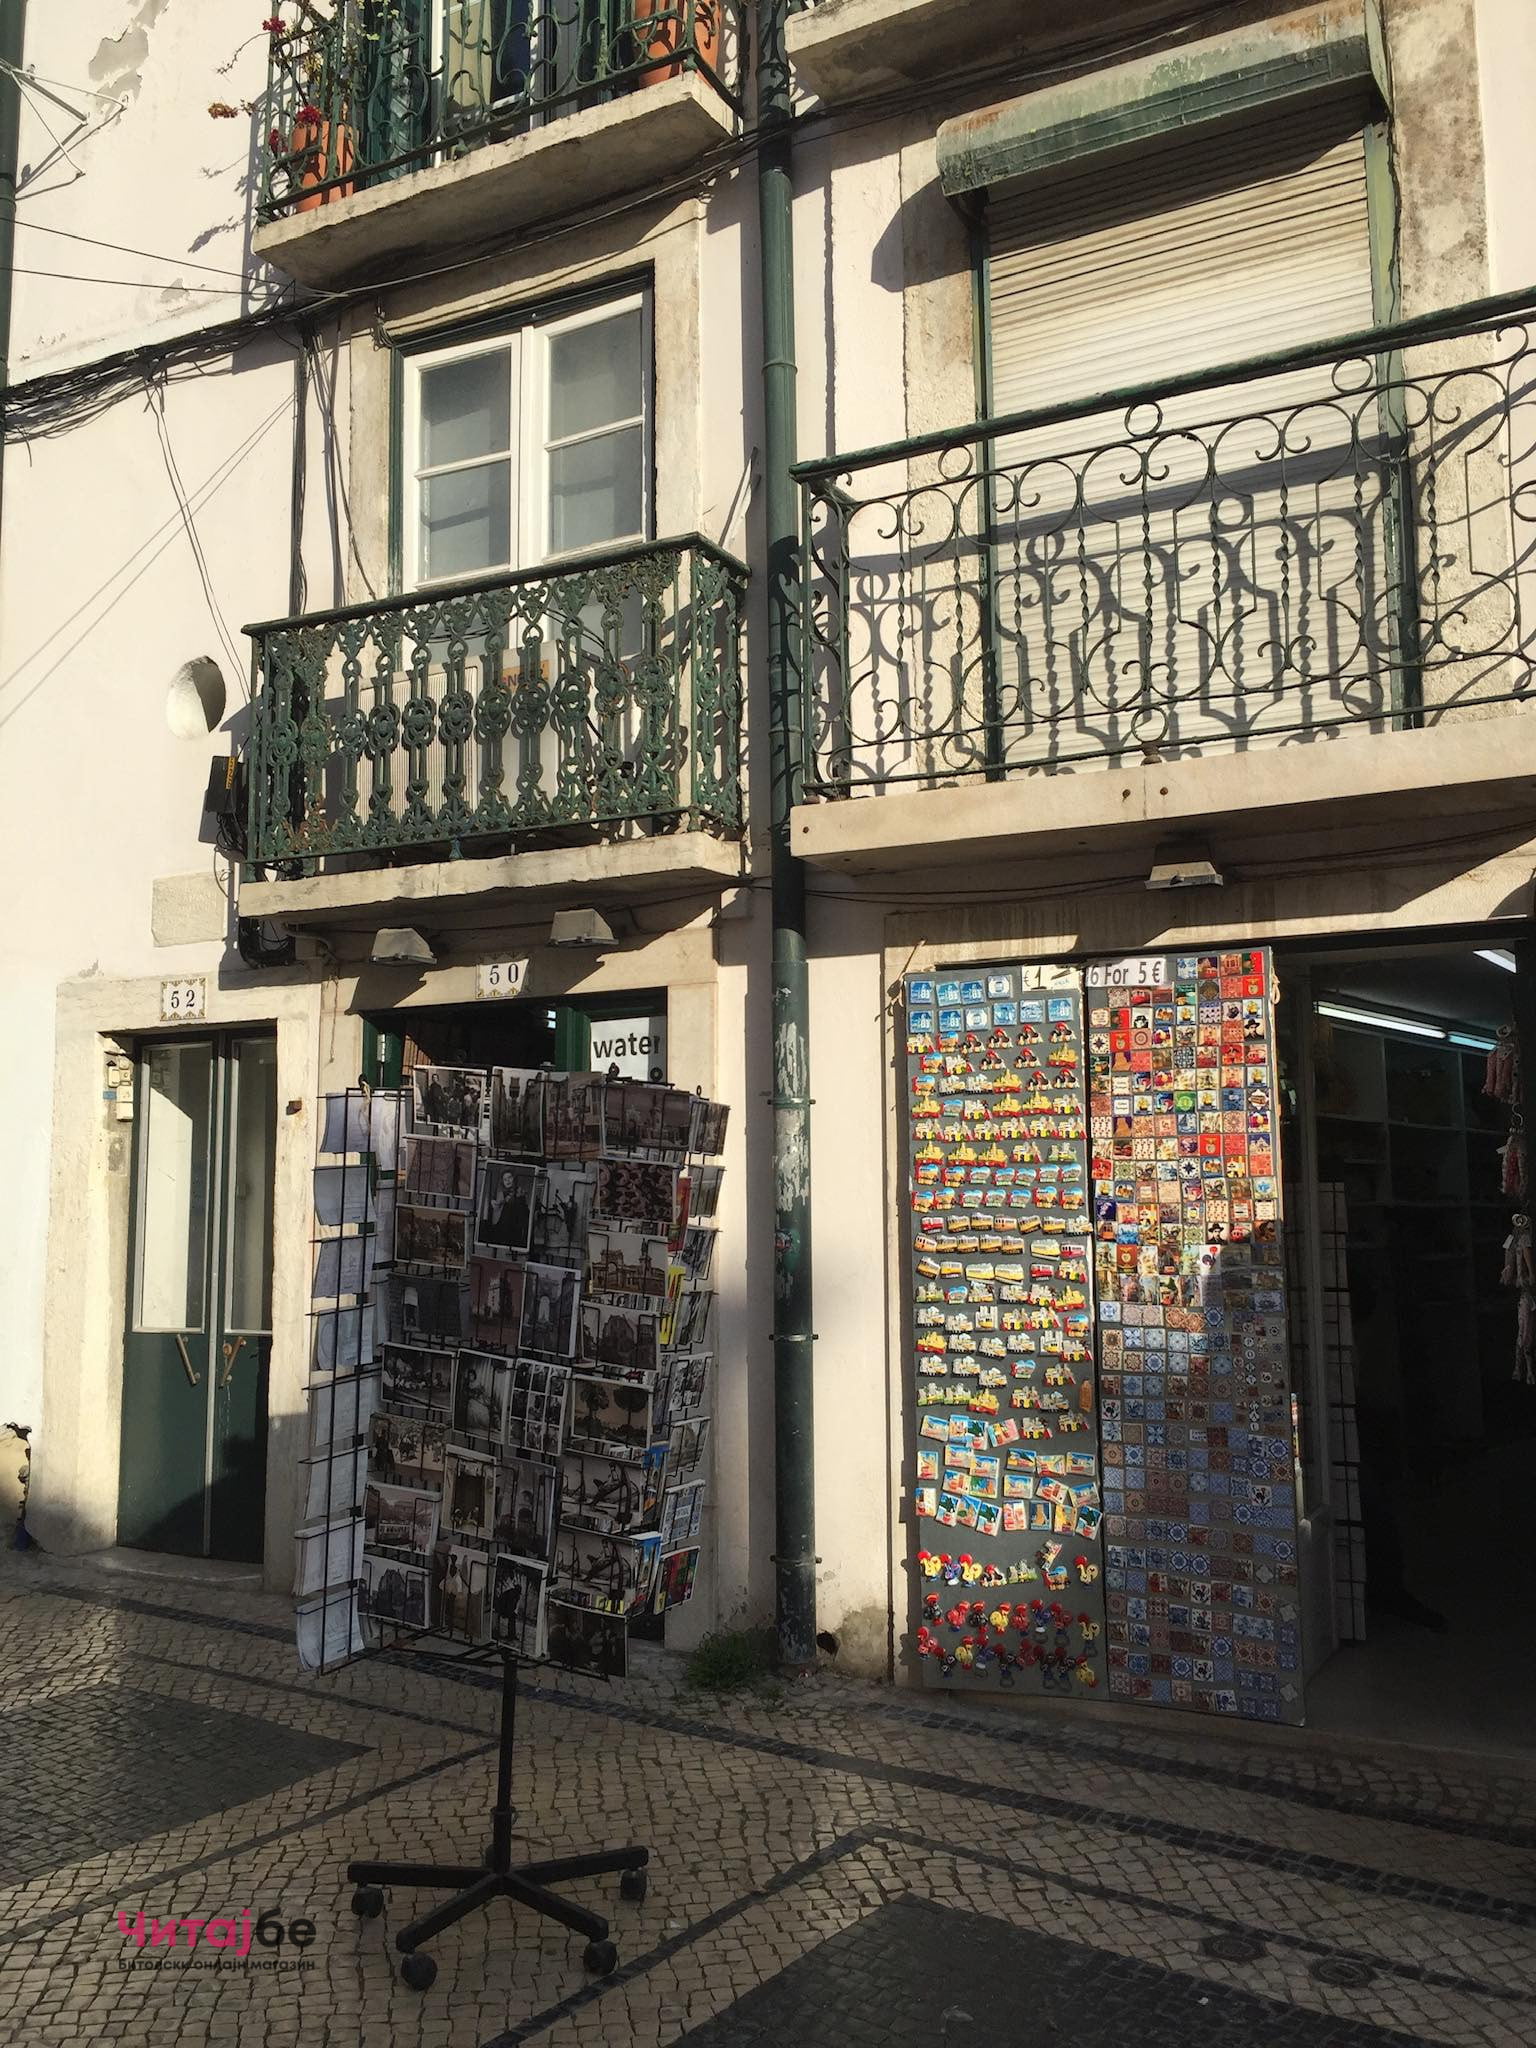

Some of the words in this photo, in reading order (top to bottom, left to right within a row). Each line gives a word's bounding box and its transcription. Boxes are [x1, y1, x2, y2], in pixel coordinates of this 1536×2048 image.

[489, 963, 519, 985] 50
[1090, 965, 1099, 985] 6
[1104, 963, 1129, 985] For
[170, 989, 195, 1009] 52
[593, 1032, 660, 1059] water
